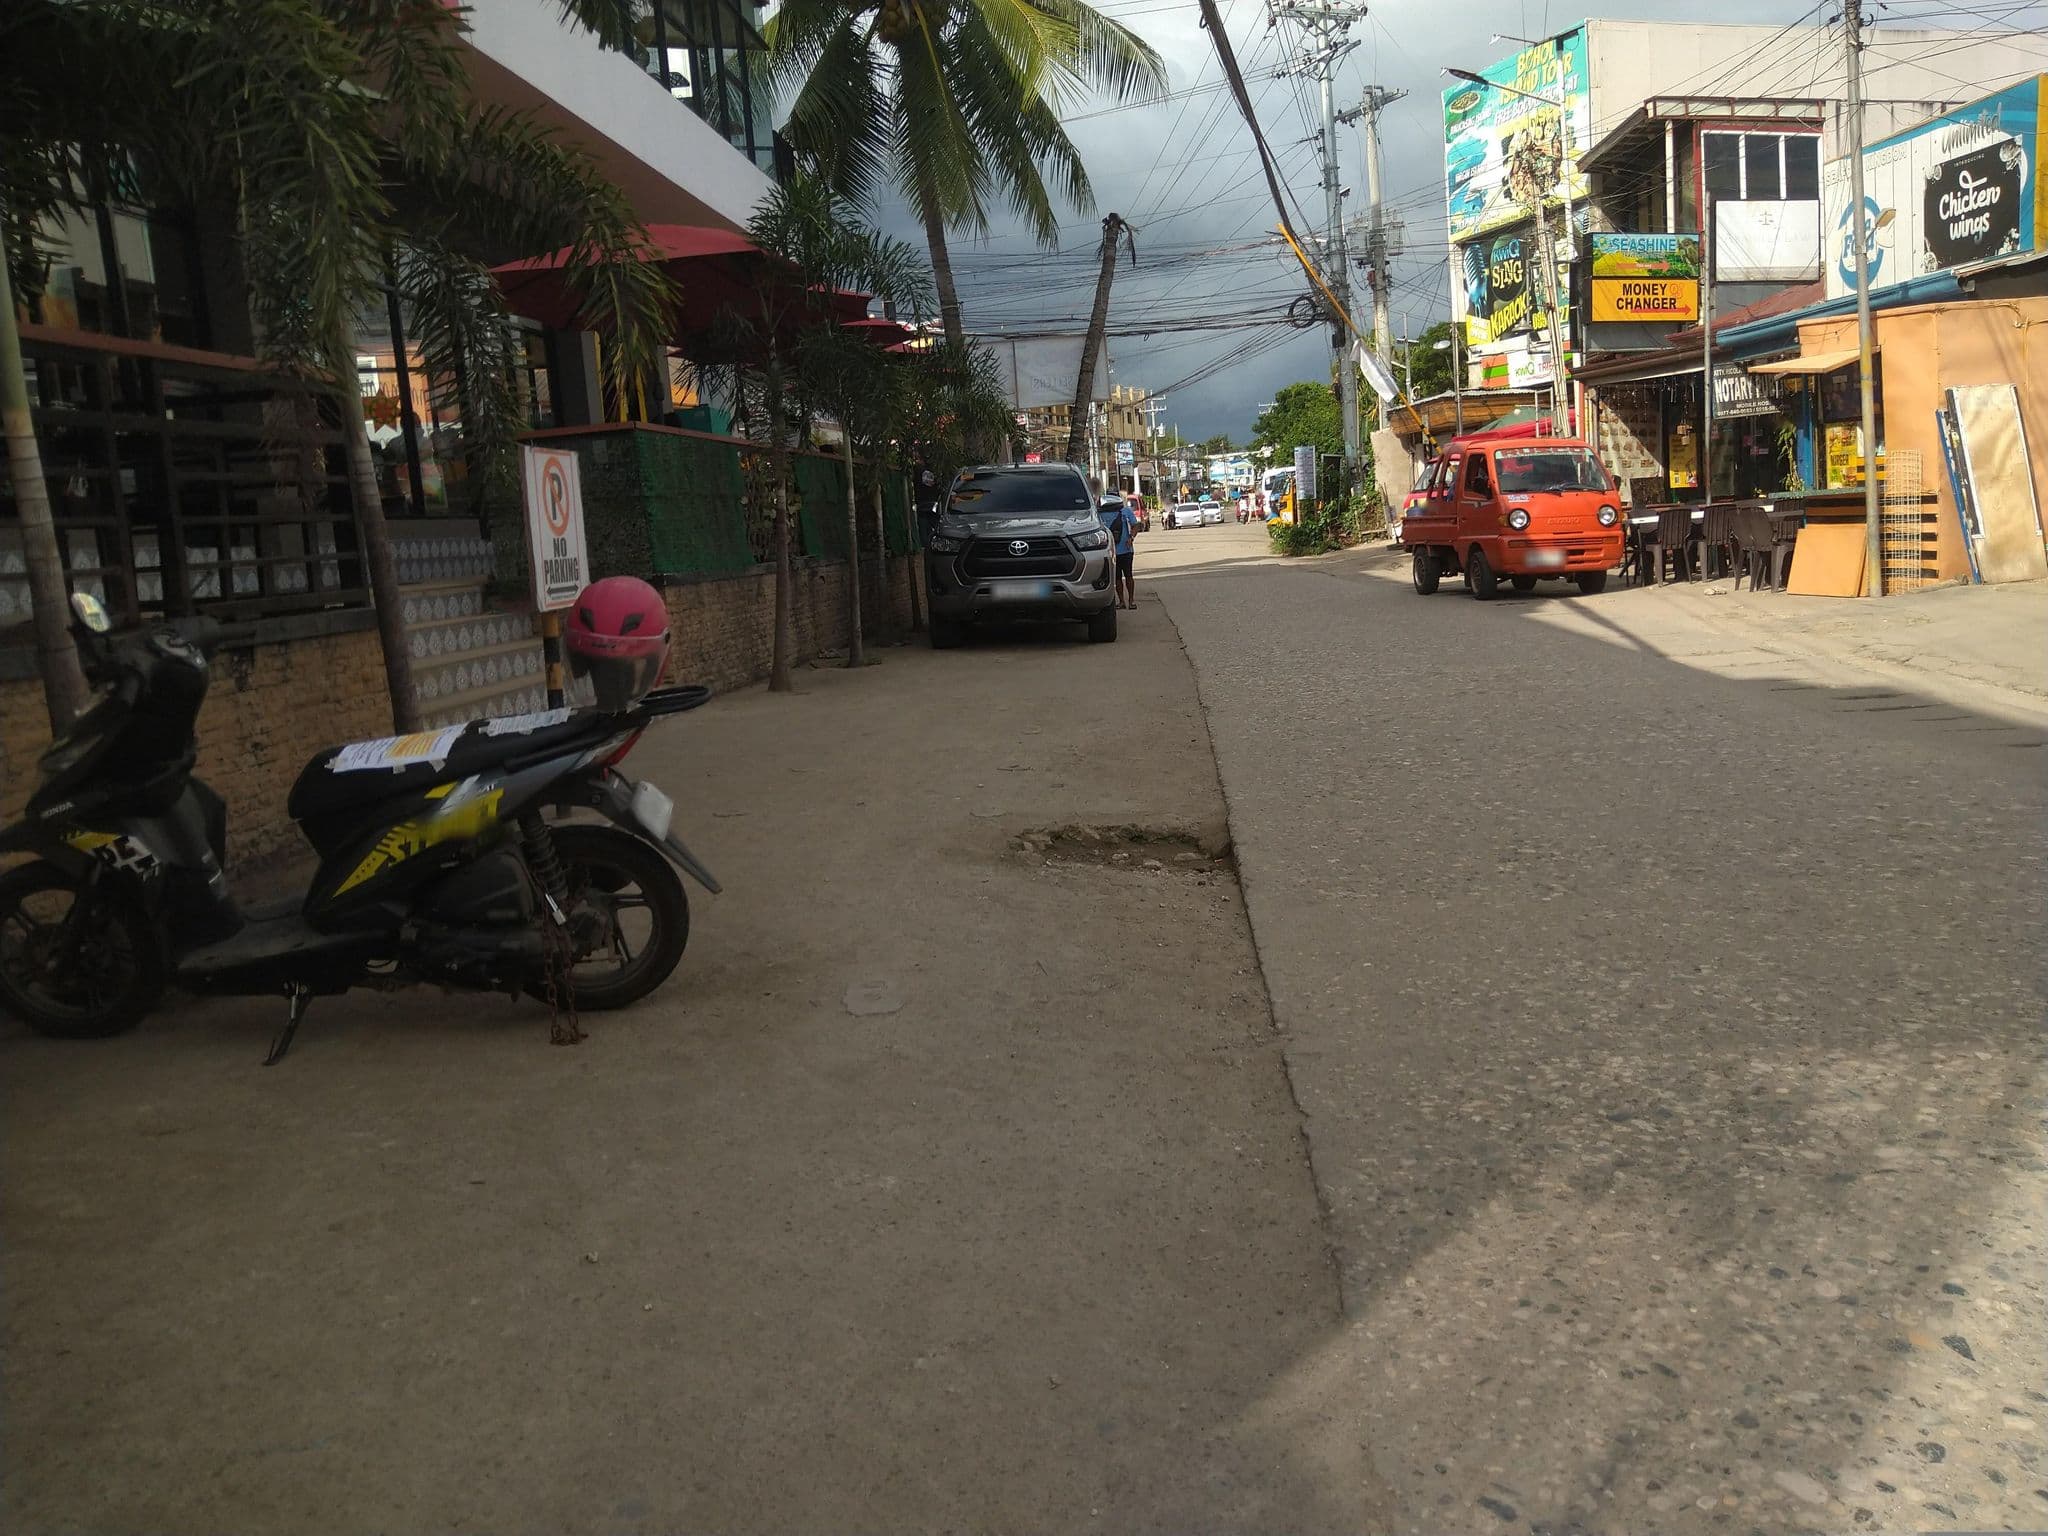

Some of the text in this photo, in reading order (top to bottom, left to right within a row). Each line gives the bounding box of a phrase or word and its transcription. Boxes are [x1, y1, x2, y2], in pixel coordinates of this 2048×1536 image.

[1517, 40, 1554, 76] BOHOL
[1542, 52, 1573, 86] TOR
[1938, 170, 2001, 221] Chicken
[1949, 212, 1991, 245] wings
[1611, 238, 1676, 251] SEASHINE
[1622, 283, 1667, 296] MONEY
[1616, 297, 1677, 310] CHANGER
[1714, 377, 1753, 403] NOTARY
[552, 537, 567, 558] NO
[544, 557, 579, 585] PARKING
